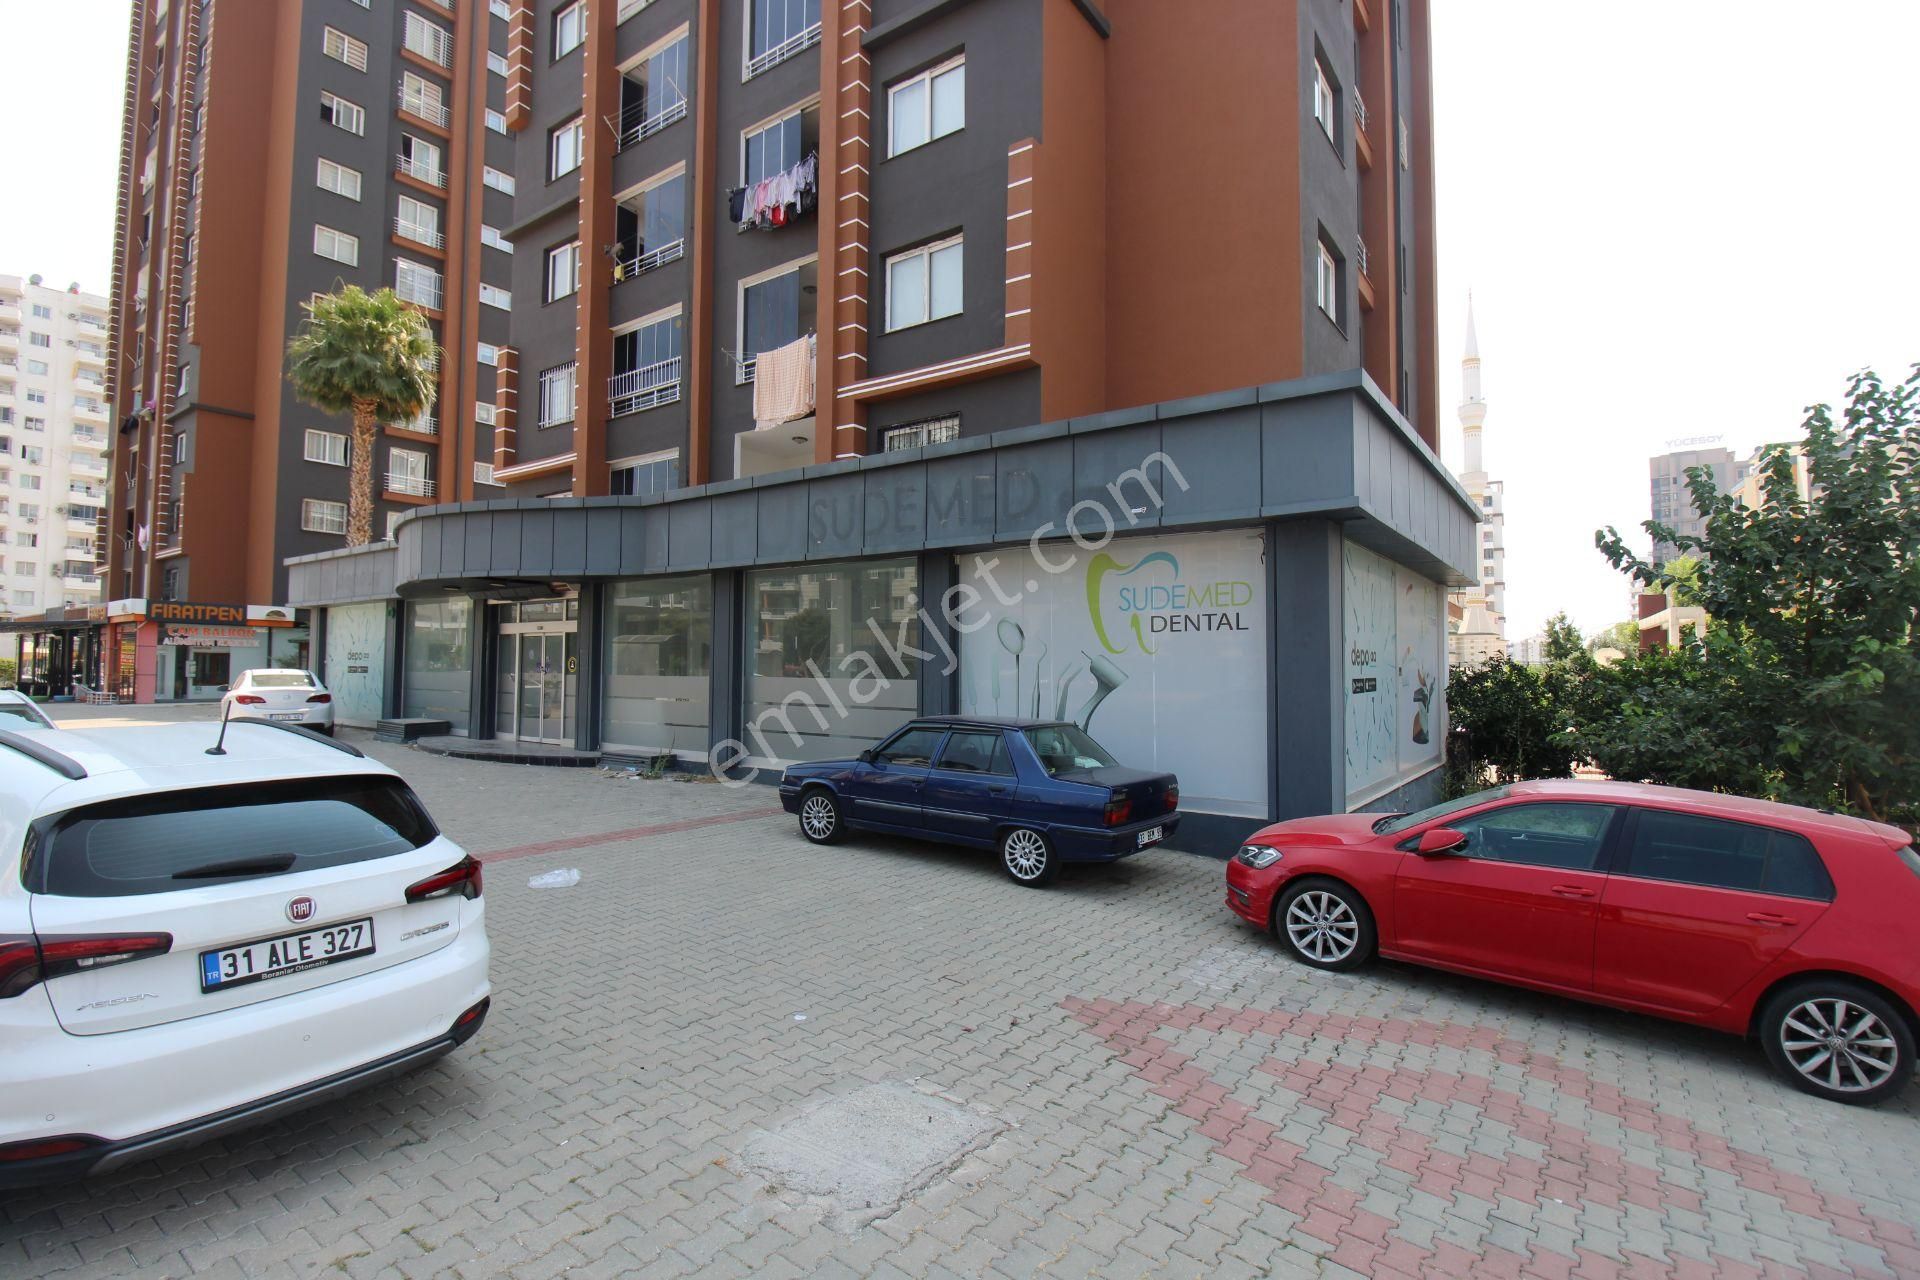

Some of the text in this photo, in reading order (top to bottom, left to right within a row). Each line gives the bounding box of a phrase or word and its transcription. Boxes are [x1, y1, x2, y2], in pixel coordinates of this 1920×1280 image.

[811, 468, 1040, 541] SUDEMED
[1118, 581, 1253, 613] SUDEMED
[151, 603, 244, 621] FIRATPEN
[1149, 612, 1249, 633] DENTAL
[293, 902, 310, 917] FIAT
[207, 925, 364, 980] TR 31 ALE 327
[261, 960, 329, 980] Boranlar Otomotiv
